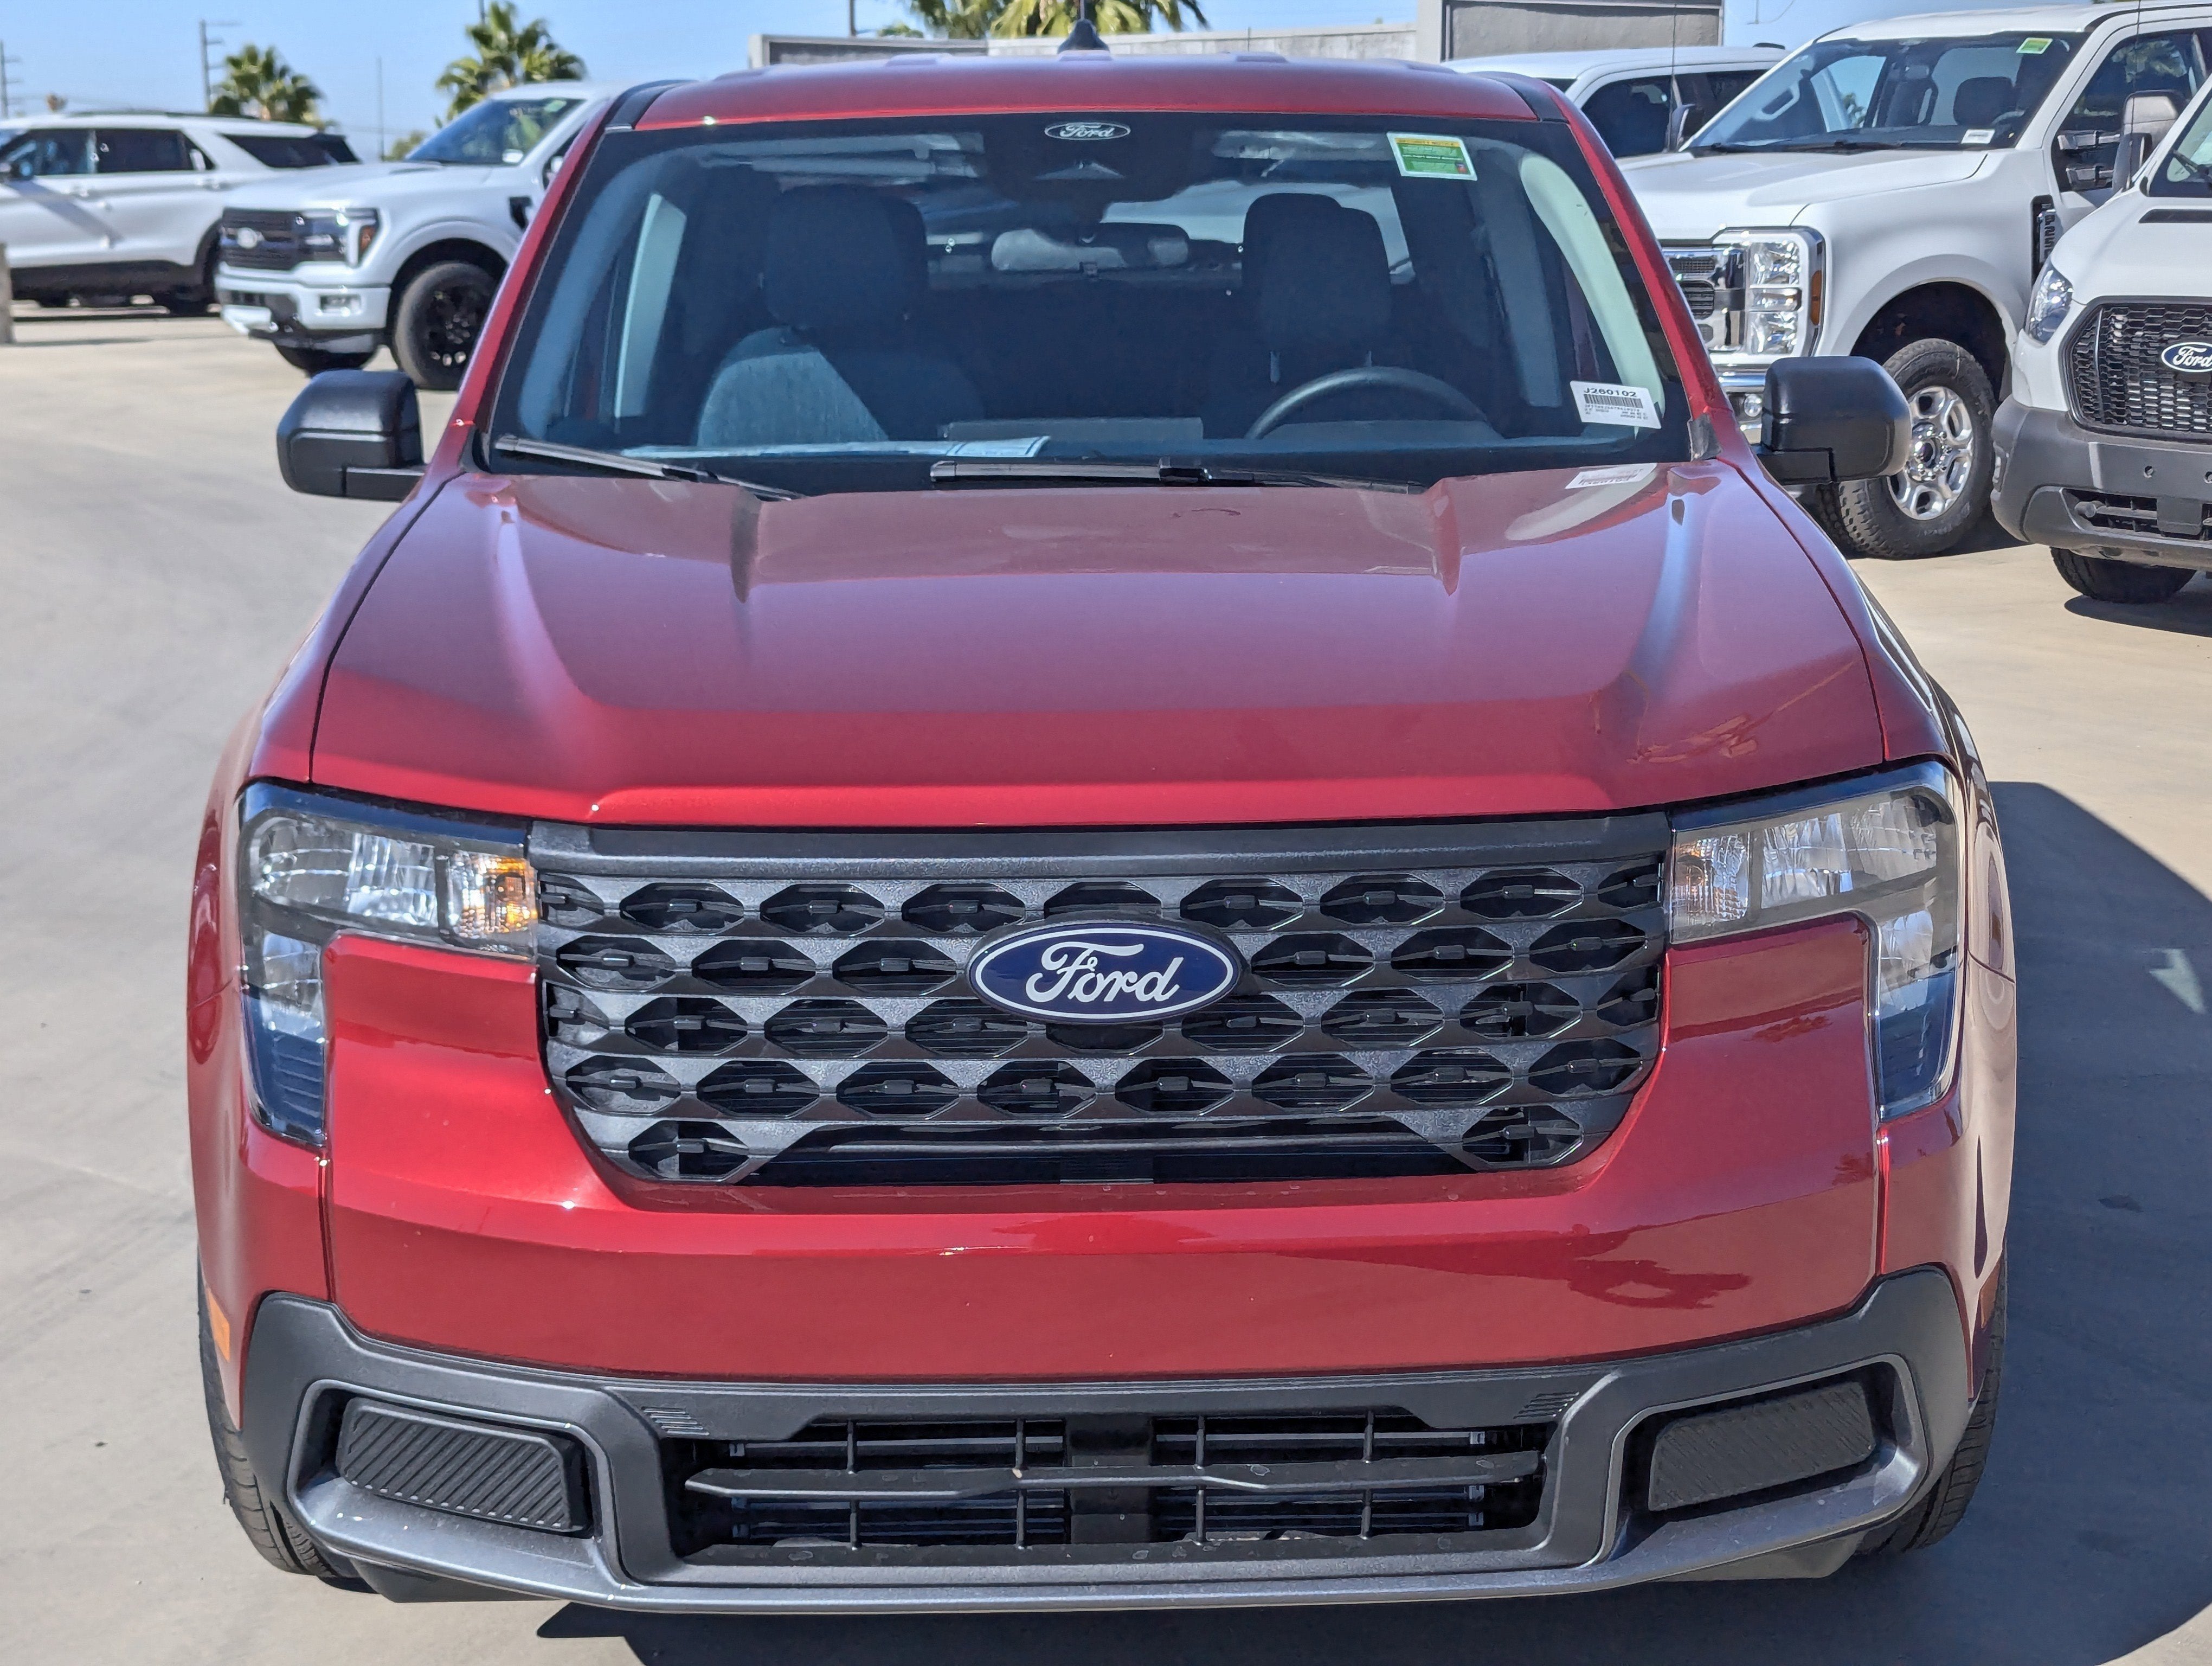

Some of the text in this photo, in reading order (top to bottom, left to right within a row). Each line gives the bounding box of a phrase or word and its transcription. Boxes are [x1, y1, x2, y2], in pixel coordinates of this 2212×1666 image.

[1059, 124, 1115, 137] Ford
[1584, 388, 1637, 398] J260102
[1026, 941, 1184, 1003] Ford
